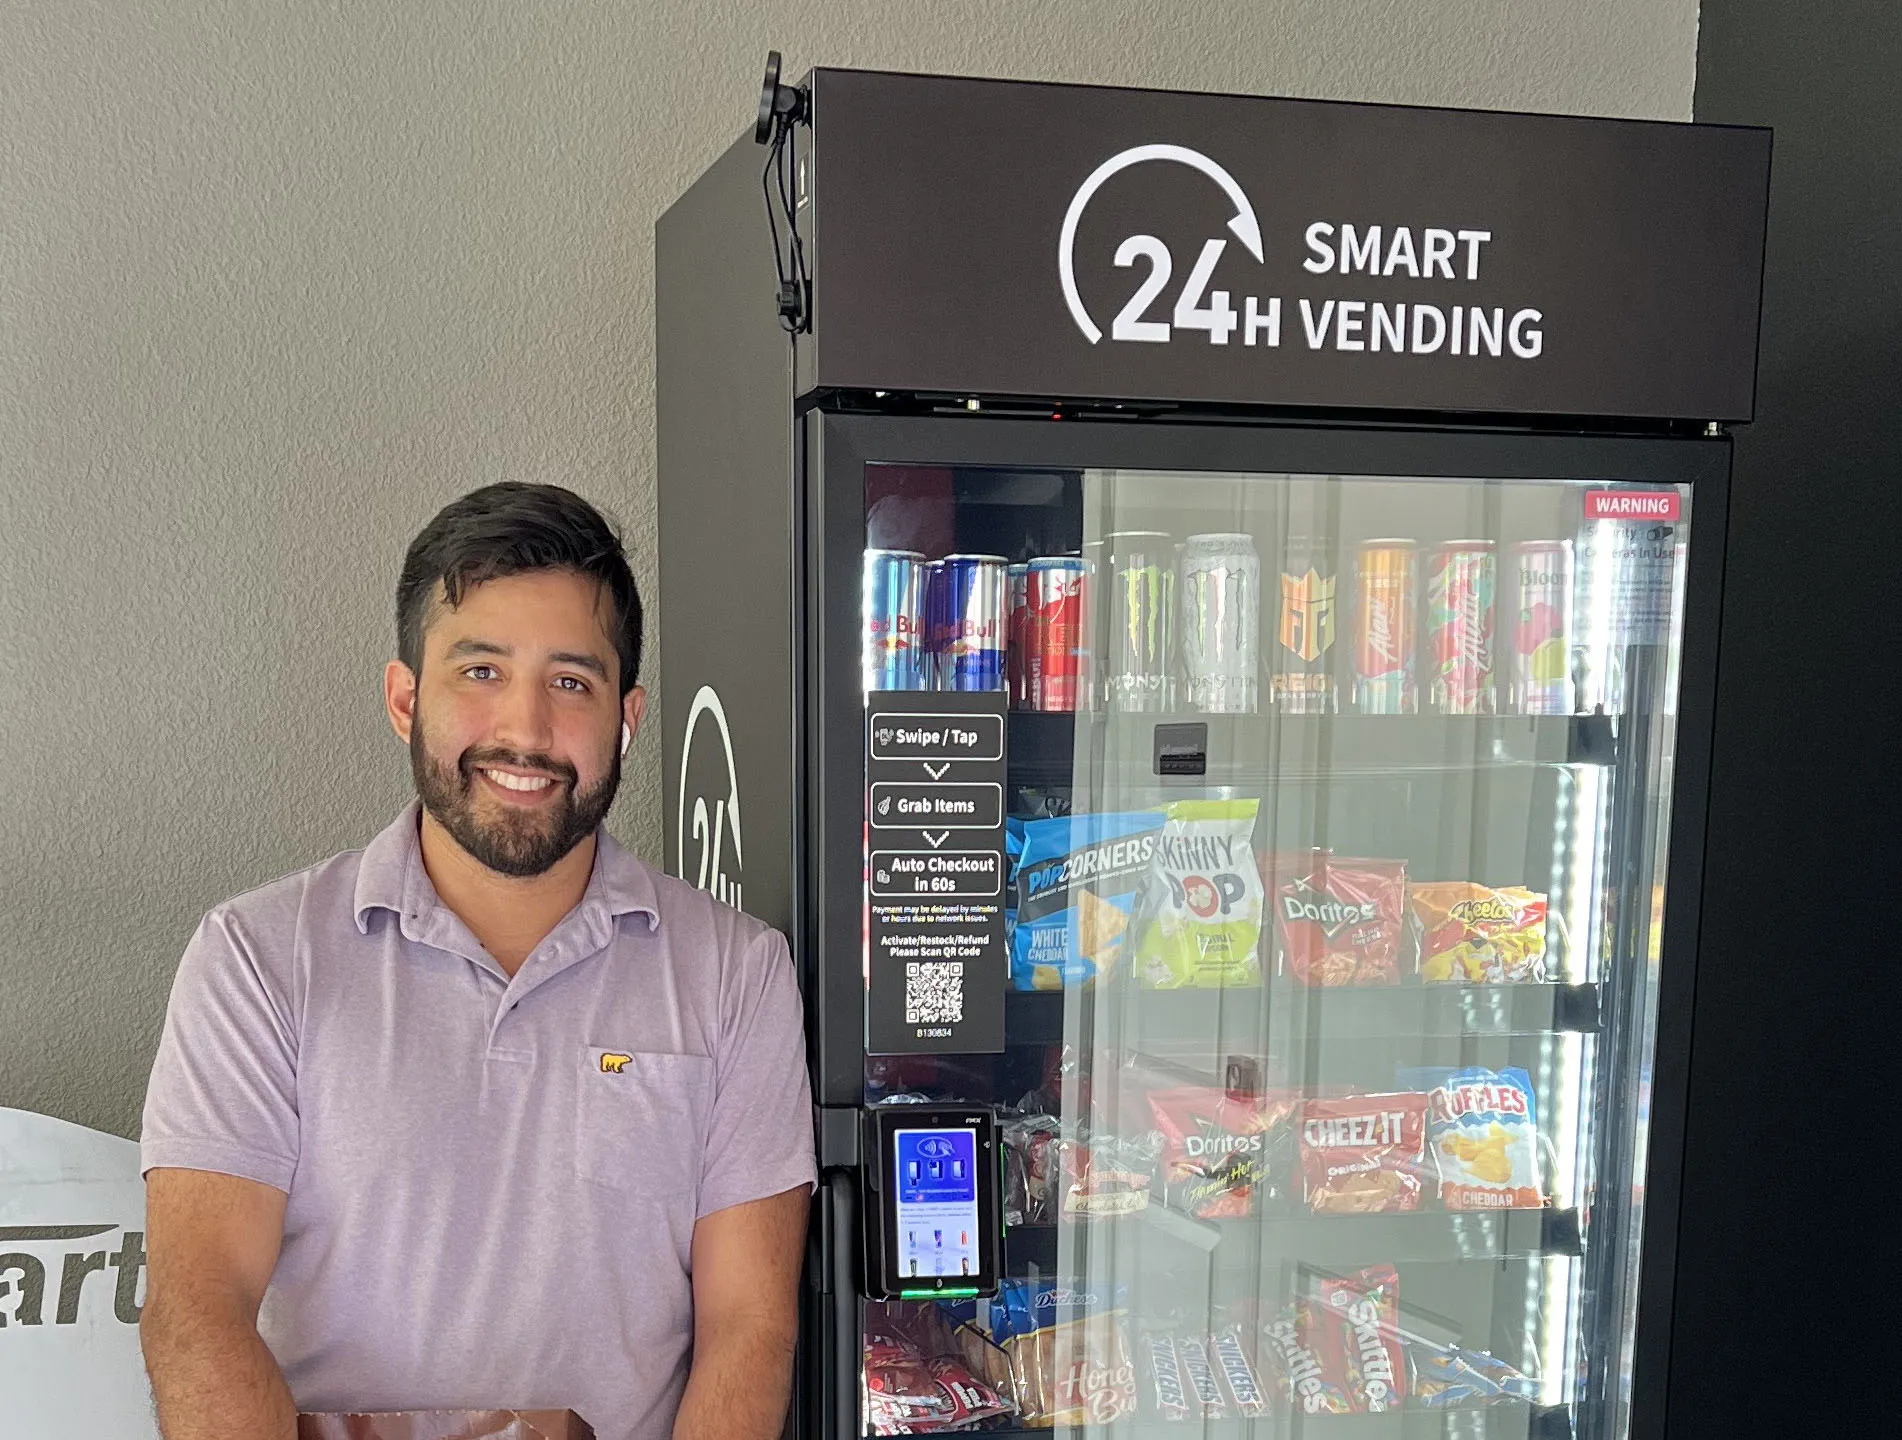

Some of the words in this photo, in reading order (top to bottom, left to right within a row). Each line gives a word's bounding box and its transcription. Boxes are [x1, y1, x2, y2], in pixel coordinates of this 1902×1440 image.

[1302, 221, 1492, 281] SMART
[1111, 234, 1281, 347] 24H
[1299, 297, 1543, 358] VENDING
[1595, 497, 1670, 514] WARNING
[895, 728, 940, 747] Swipe
[951, 729, 978, 747] Tap
[897, 797, 932, 814] Grab
[935, 798, 976, 814] Items
[891, 857, 926, 873] Auto
[928, 856, 995, 873] Checkout
[1027, 835, 1154, 895] POPCORNERS
[915, 876, 929, 892] in
[931, 876, 956, 892] 60s
[1283, 896, 1378, 923] Doritos
[880, 934, 990, 947] Activate/Restock/Refund
[1031, 927, 1070, 949] WHITE
[890, 946, 919, 957] Please
[920, 946, 942, 957] Scan
[943, 946, 957, 958] QR
[957, 946, 981, 957] Code
[1429, 1084, 1527, 1123] RUFFLES
[1186, 1134, 1262, 1157] Doritos
[1462, 1191, 1514, 1207] CHEDDAR
